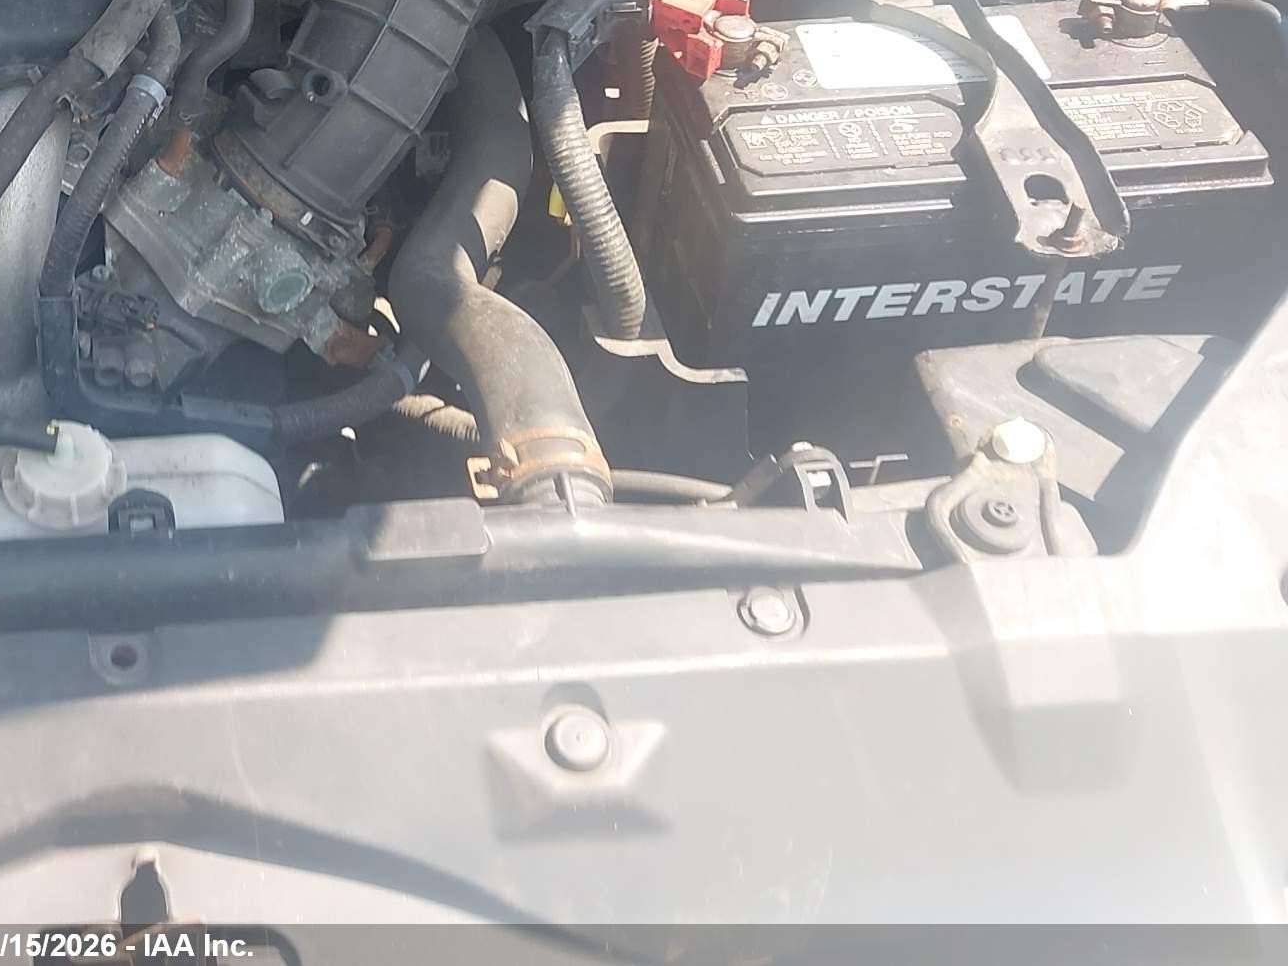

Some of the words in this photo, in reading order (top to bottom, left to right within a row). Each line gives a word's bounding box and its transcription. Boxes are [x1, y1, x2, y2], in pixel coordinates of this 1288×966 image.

[775, 109, 840, 124] DANGER
[854, 105, 914, 118] POISON
[752, 264, 1182, 327] INTERSTATE
